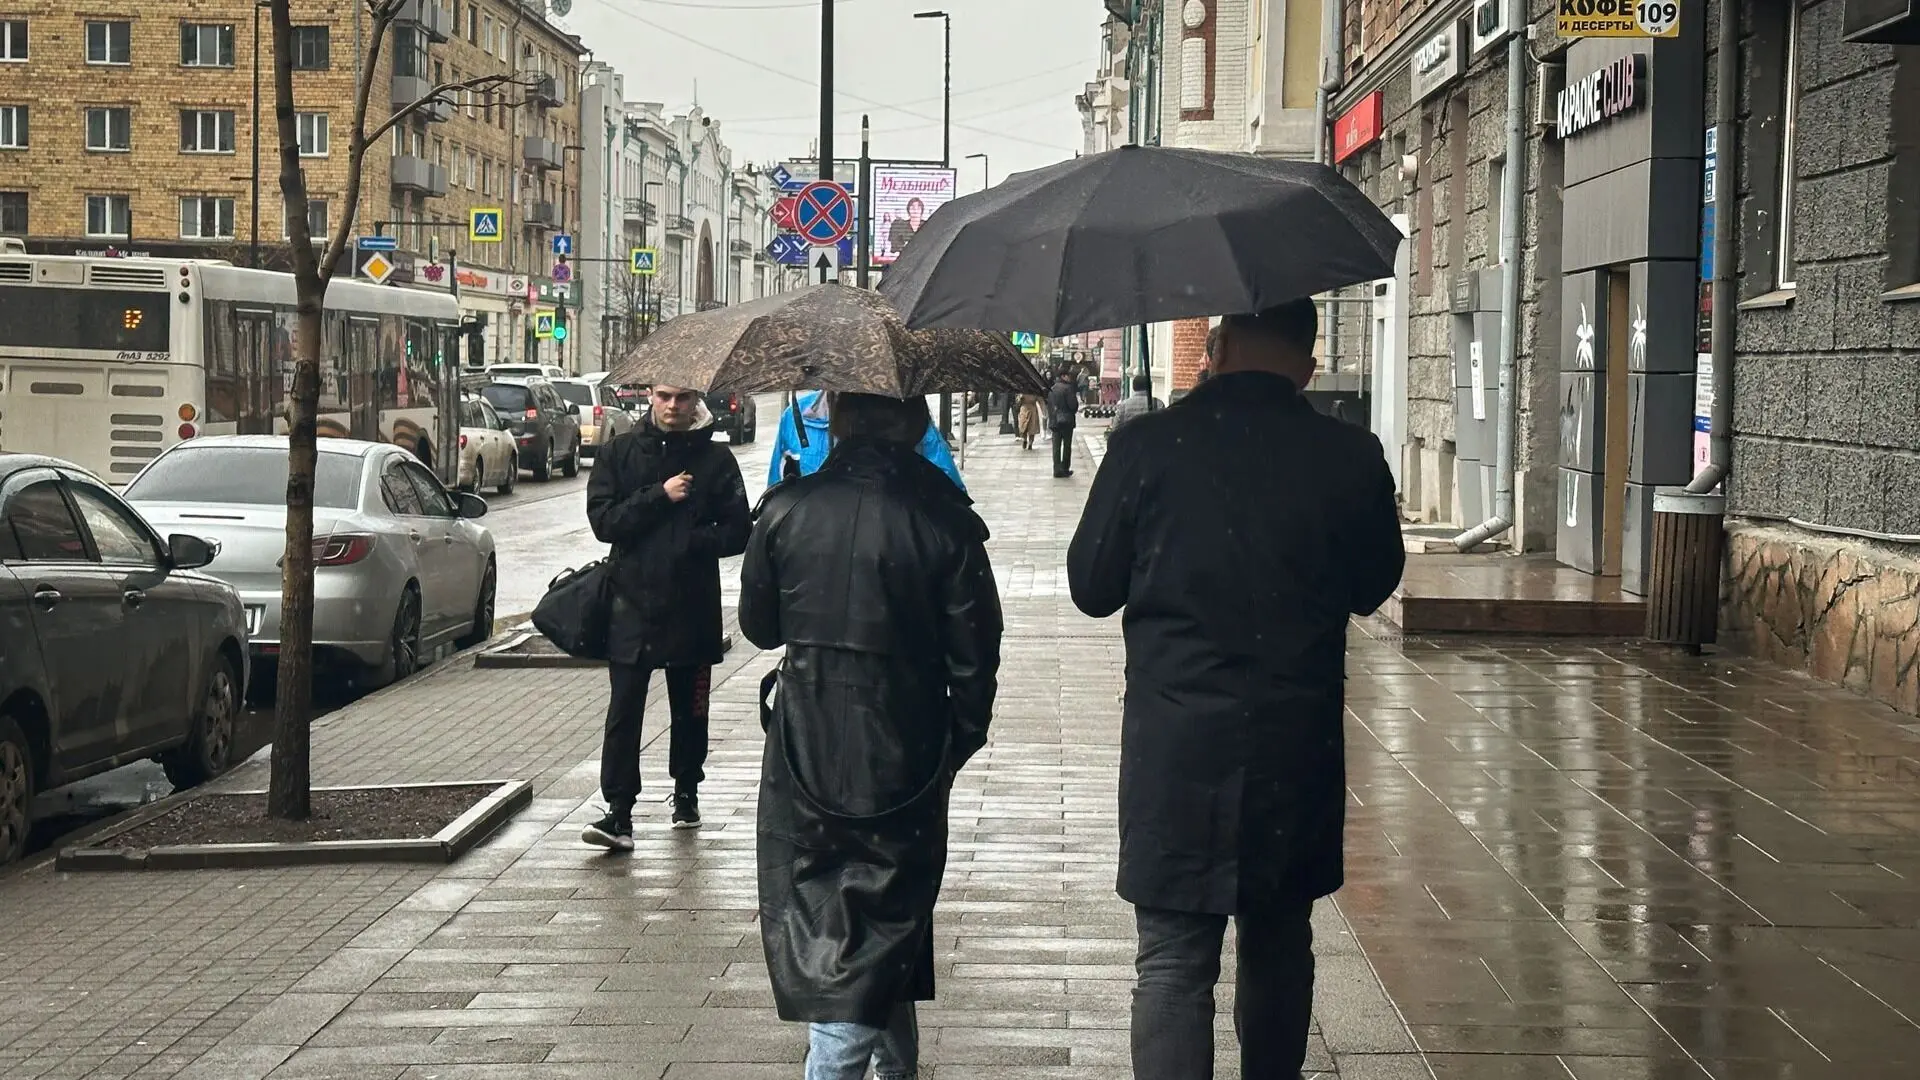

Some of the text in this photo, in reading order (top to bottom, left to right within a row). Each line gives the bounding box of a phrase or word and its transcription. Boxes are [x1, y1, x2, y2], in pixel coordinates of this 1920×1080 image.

[1559, 0, 1634, 17] КОФЕ
[1637, 3, 1677, 23] 109
[1559, 20, 1634, 32] И ДЕСЕРТЫ
[1557, 54, 1635, 139] КАРАОКЕ CLUB
[146, 353, 171, 361] 5292
